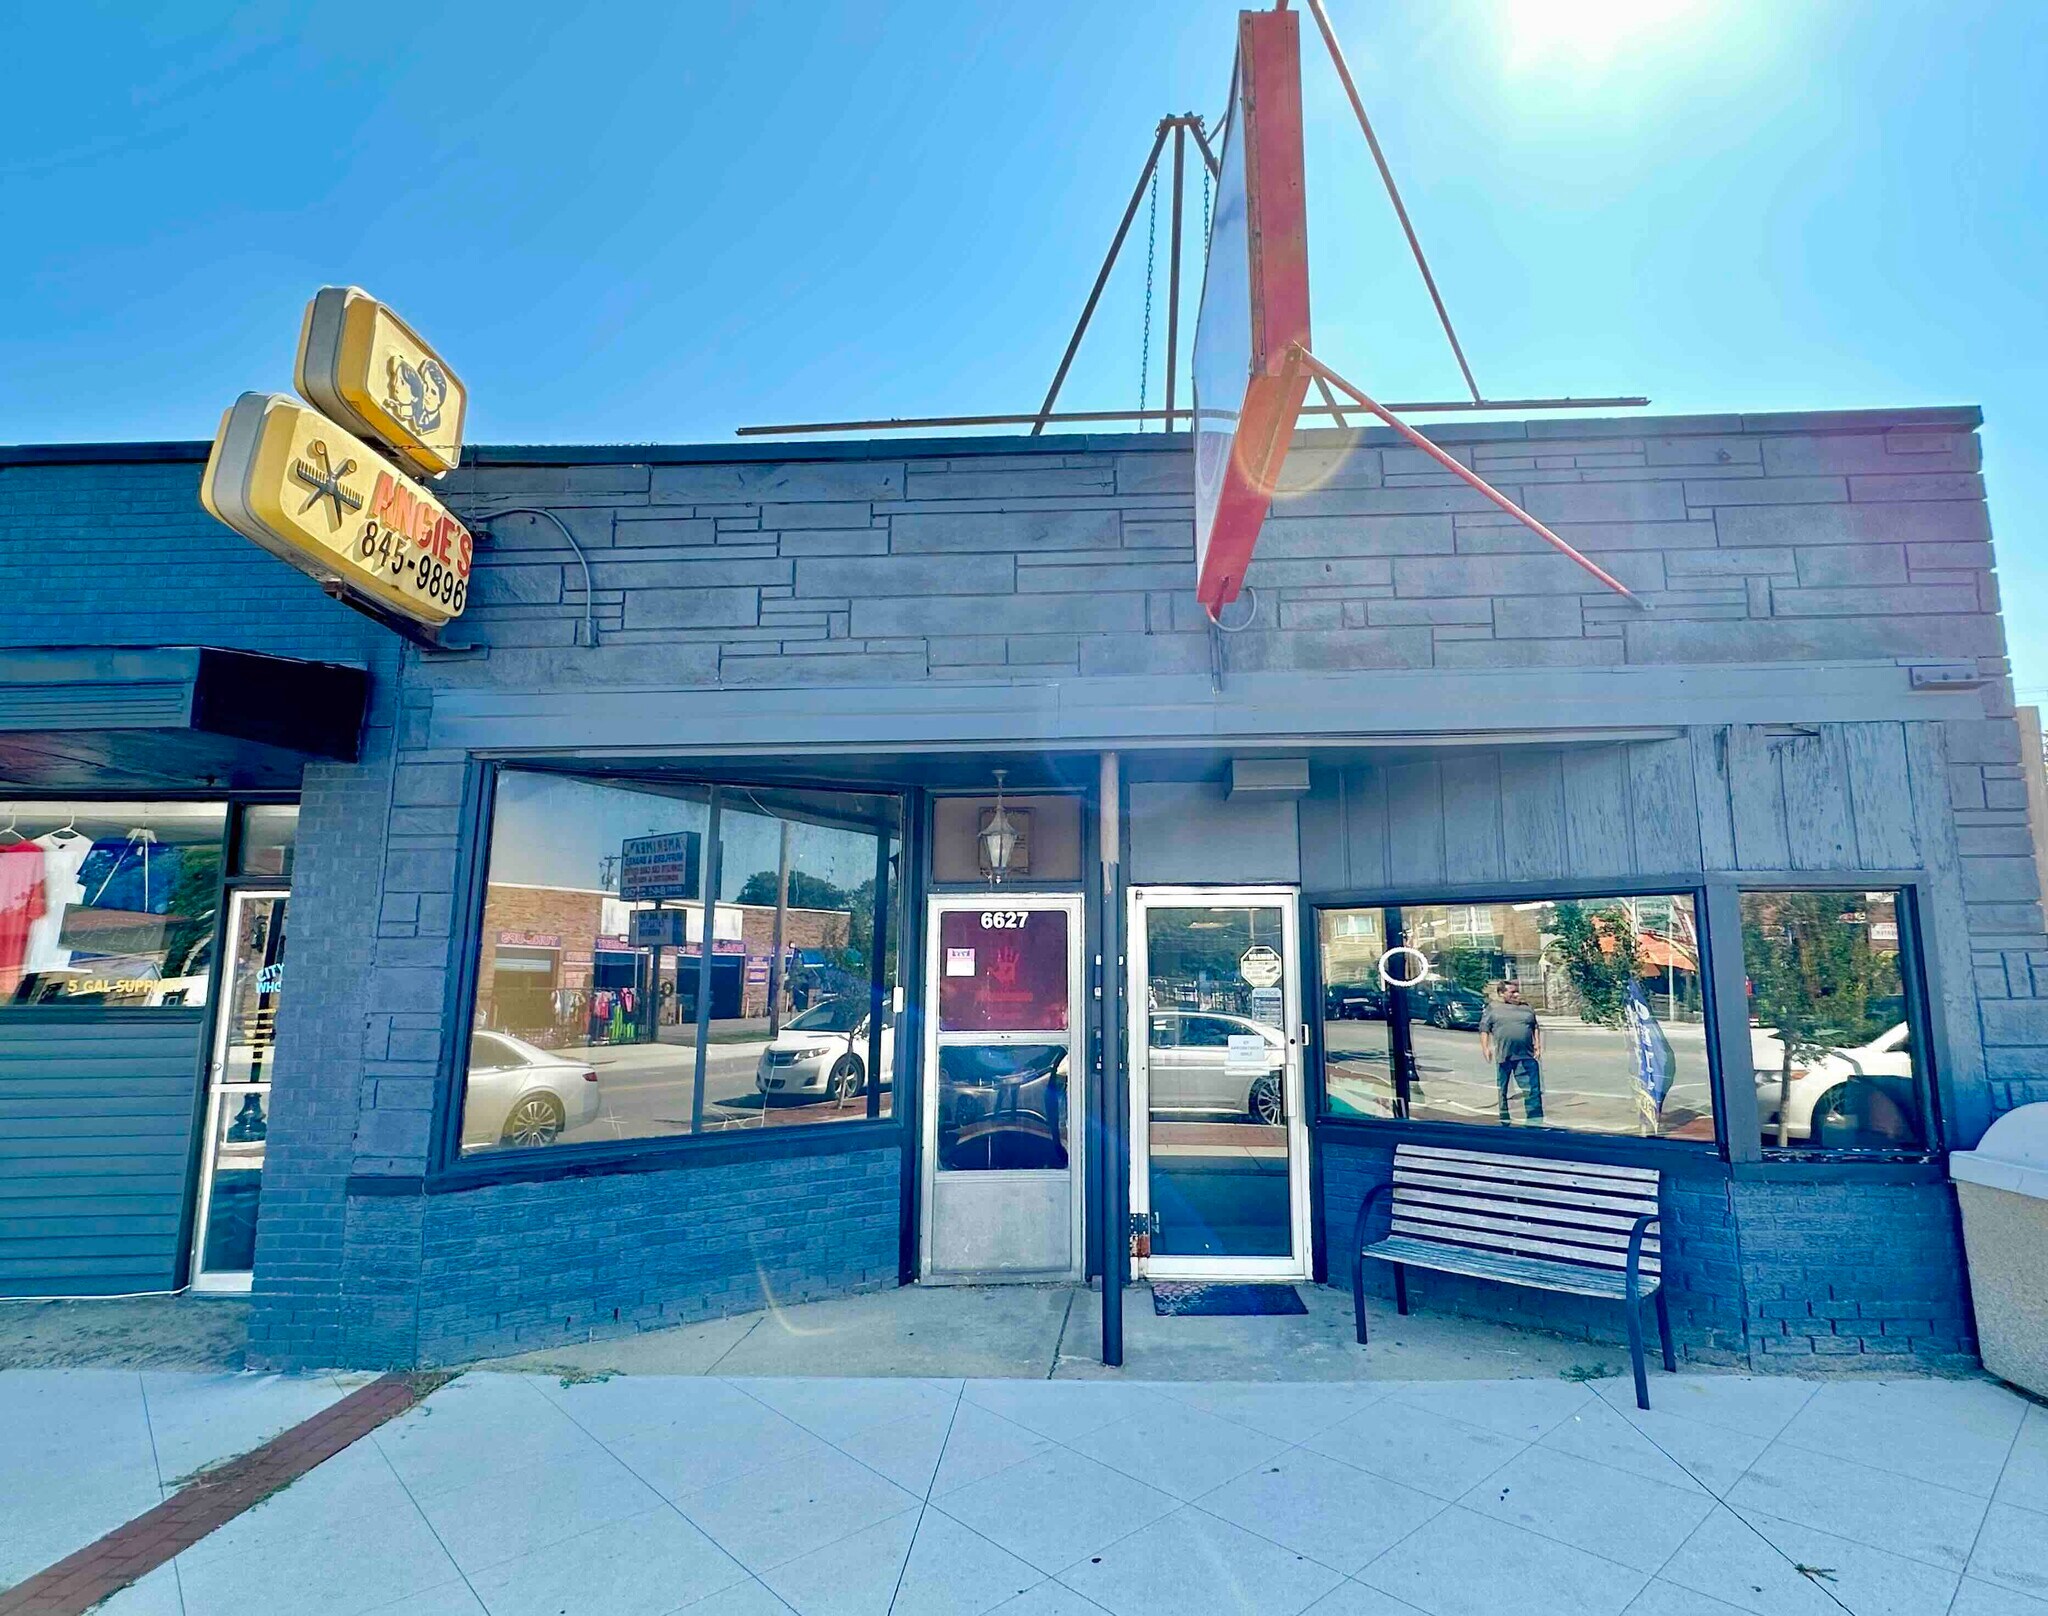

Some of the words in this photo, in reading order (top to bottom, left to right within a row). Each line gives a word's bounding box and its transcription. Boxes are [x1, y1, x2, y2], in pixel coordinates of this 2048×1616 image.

[366, 469, 472, 579] ANGIE'S
[361, 520, 466, 612] 845-9896
[980, 911, 1029, 930] 6627
[256, 962, 285, 982] CITY
[68, 980, 78, 993] 5
[83, 980, 111, 993] GAL
[1254, 989, 1280, 997] NOTICE
